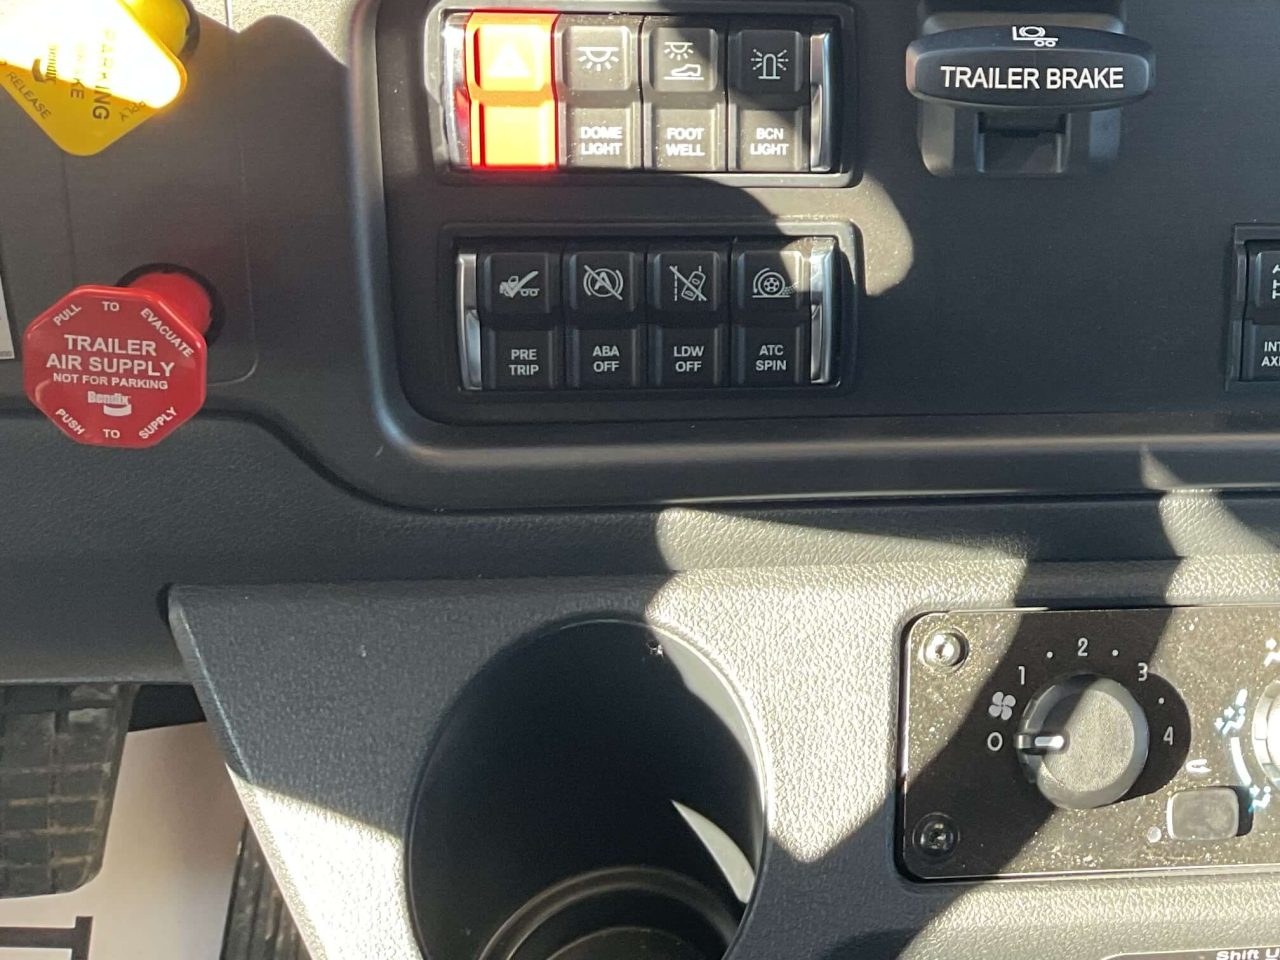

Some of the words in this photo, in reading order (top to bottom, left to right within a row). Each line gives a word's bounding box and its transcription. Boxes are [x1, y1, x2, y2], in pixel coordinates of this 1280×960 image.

[940, 65, 1041, 90] TRAILER
[1046, 66, 1124, 89] BRAKE
[6, 71, 52, 120] RELEASE
[580, 126, 623, 140] DOME
[667, 127, 705, 140] FOOT
[756, 127, 784, 140] BCN
[580, 142, 623, 156] LIGHT
[666, 143, 705, 157] WELL
[750, 143, 789, 156] LIGHT
[53, 304, 82, 326] PULL
[101, 300, 120, 312] TO
[140, 308, 194, 358] EVACUATE
[63, 334, 157, 356] TRAILER
[592, 345, 620, 358] ABA
[673, 345, 705, 358] LDW
[759, 344, 784, 357] ATC
[511, 348, 537, 361] PRE
[46, 353, 83, 370] AIR
[88, 358, 175, 377] SUPPLY
[509, 364, 539, 376] TRIP
[593, 360, 620, 373] OFF
[675, 360, 702, 373] OFF
[755, 359, 787, 372] SPIN
[53, 372, 79, 384] NOT
[82, 375, 109, 386] FOR
[111, 377, 169, 390] PARKING
[55, 408, 86, 435] PUSH
[103, 428, 120, 439] TO
[138, 406, 178, 440] SUPPLY
[1077, 637, 1088, 657] 2
[1018, 665, 1026, 685] 1
[1137, 662, 1148, 682] 3
[1163, 726, 1174, 746] 4
[1216, 949, 1260, 960] Shift
